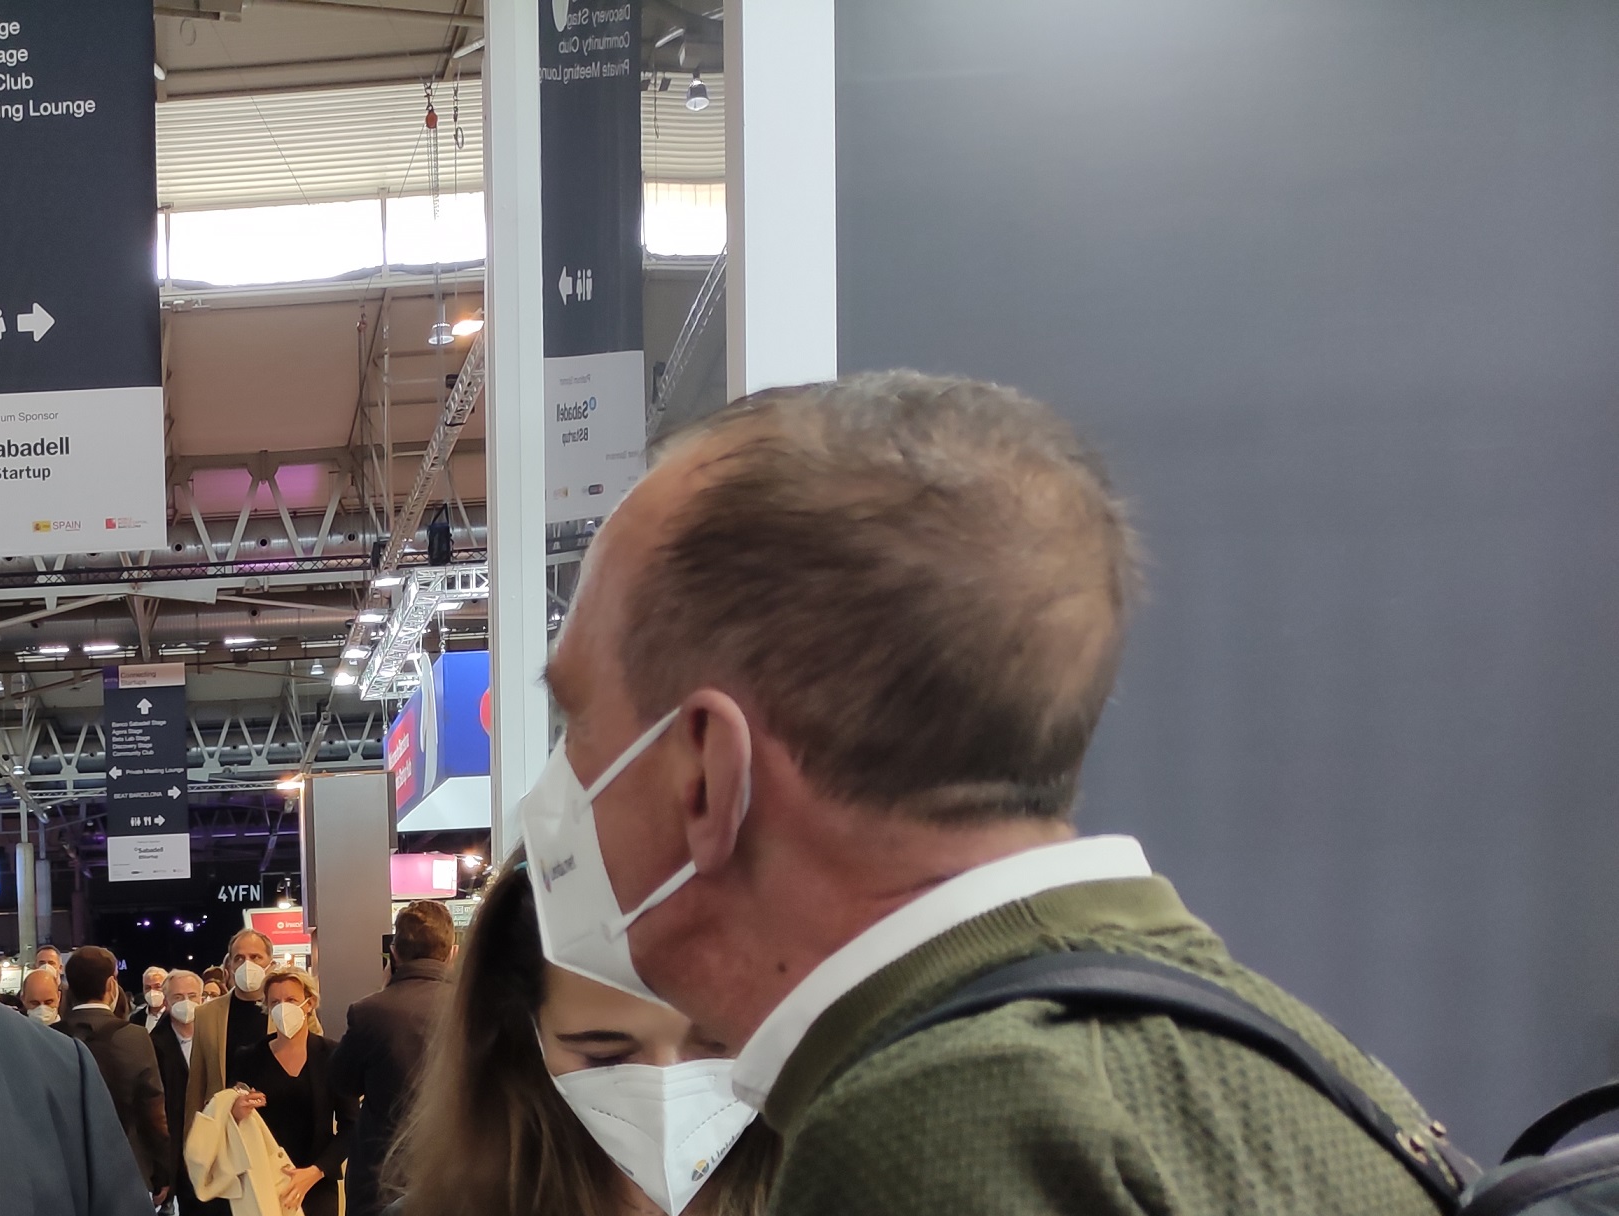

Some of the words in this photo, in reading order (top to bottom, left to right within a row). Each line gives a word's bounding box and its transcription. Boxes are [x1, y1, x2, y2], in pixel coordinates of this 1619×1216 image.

[29, 98, 96, 118] Lounge
[18, 411, 59, 424] Sponsor
[52, 520, 81, 530] SPAIN
[217, 884, 261, 902] 4YFN
